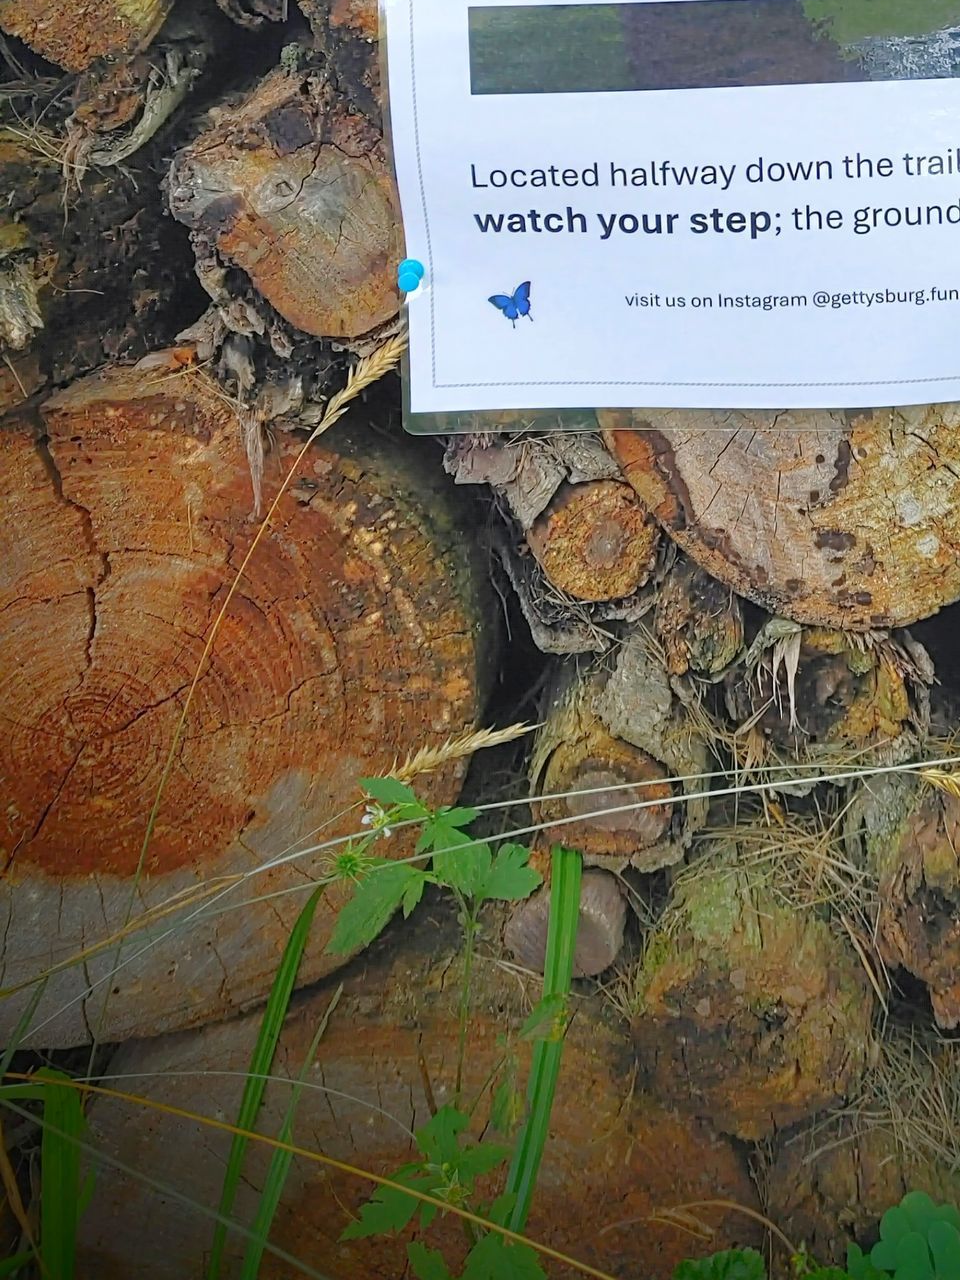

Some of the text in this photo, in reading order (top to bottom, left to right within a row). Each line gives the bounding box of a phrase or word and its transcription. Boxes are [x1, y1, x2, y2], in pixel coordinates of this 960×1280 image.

[471, 162, 599, 188] Located
[610, 161, 736, 190] halfway
[746, 157, 832, 183] down
[842, 153, 893, 178] the
[473, 206, 587, 233] watch
[596, 213, 679, 240] your
[690, 208, 781, 239] step;
[791, 205, 843, 230] the
[625, 293, 661, 307] visit
[666, 297, 686, 307] us
[691, 297, 712, 307] on
[719, 294, 807, 311] Instagram
